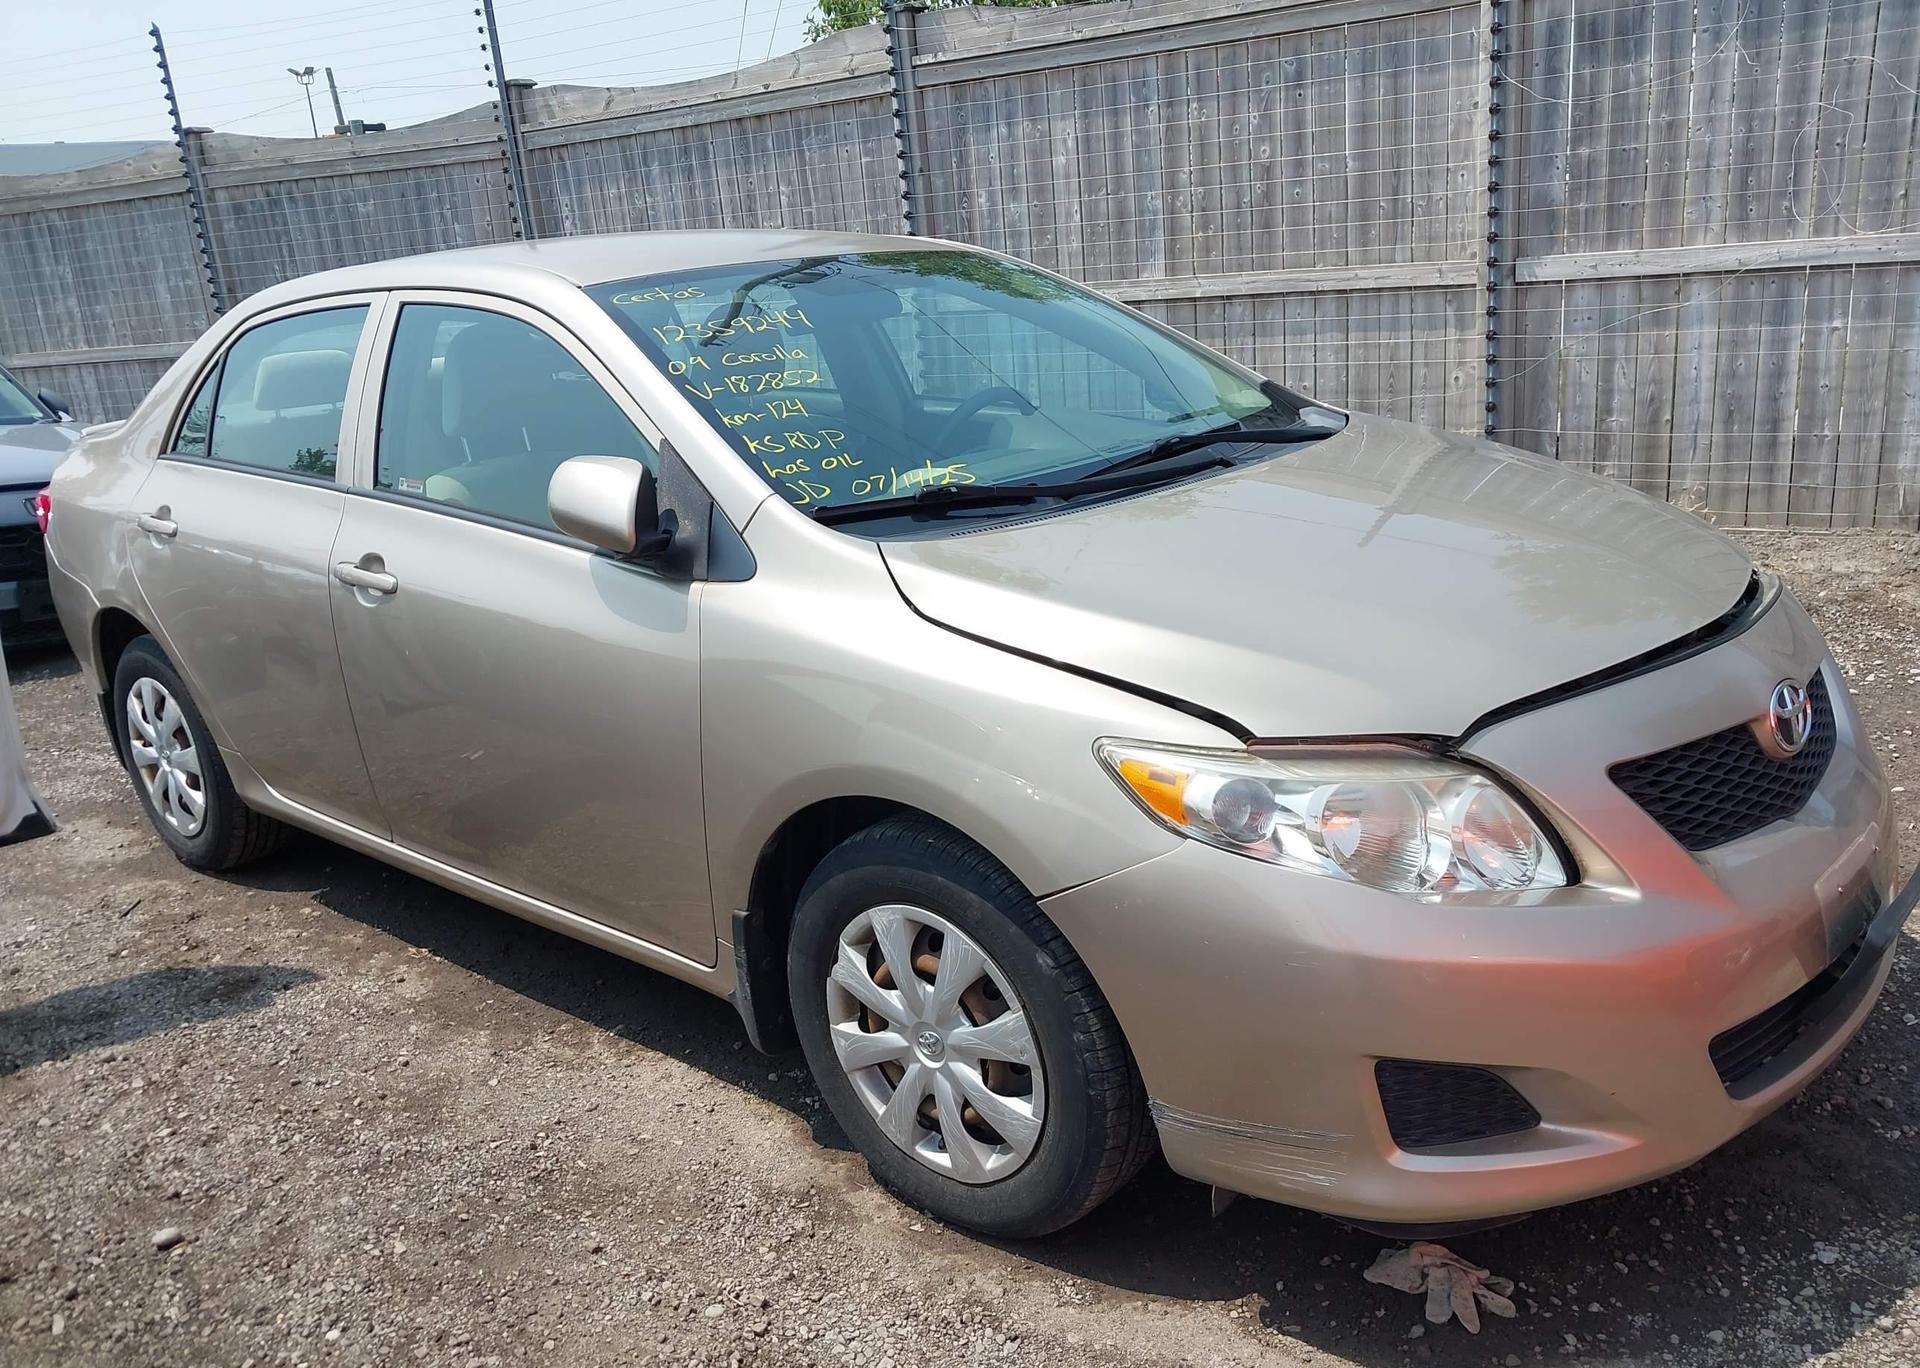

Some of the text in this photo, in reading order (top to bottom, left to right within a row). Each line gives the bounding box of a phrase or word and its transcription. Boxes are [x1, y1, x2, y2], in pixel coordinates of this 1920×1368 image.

[653, 308, 814, 345] 12359244
[668, 355, 711, 375] 09
[762, 460, 812, 479] has
[785, 459, 976, 505] JD 07/14/25
